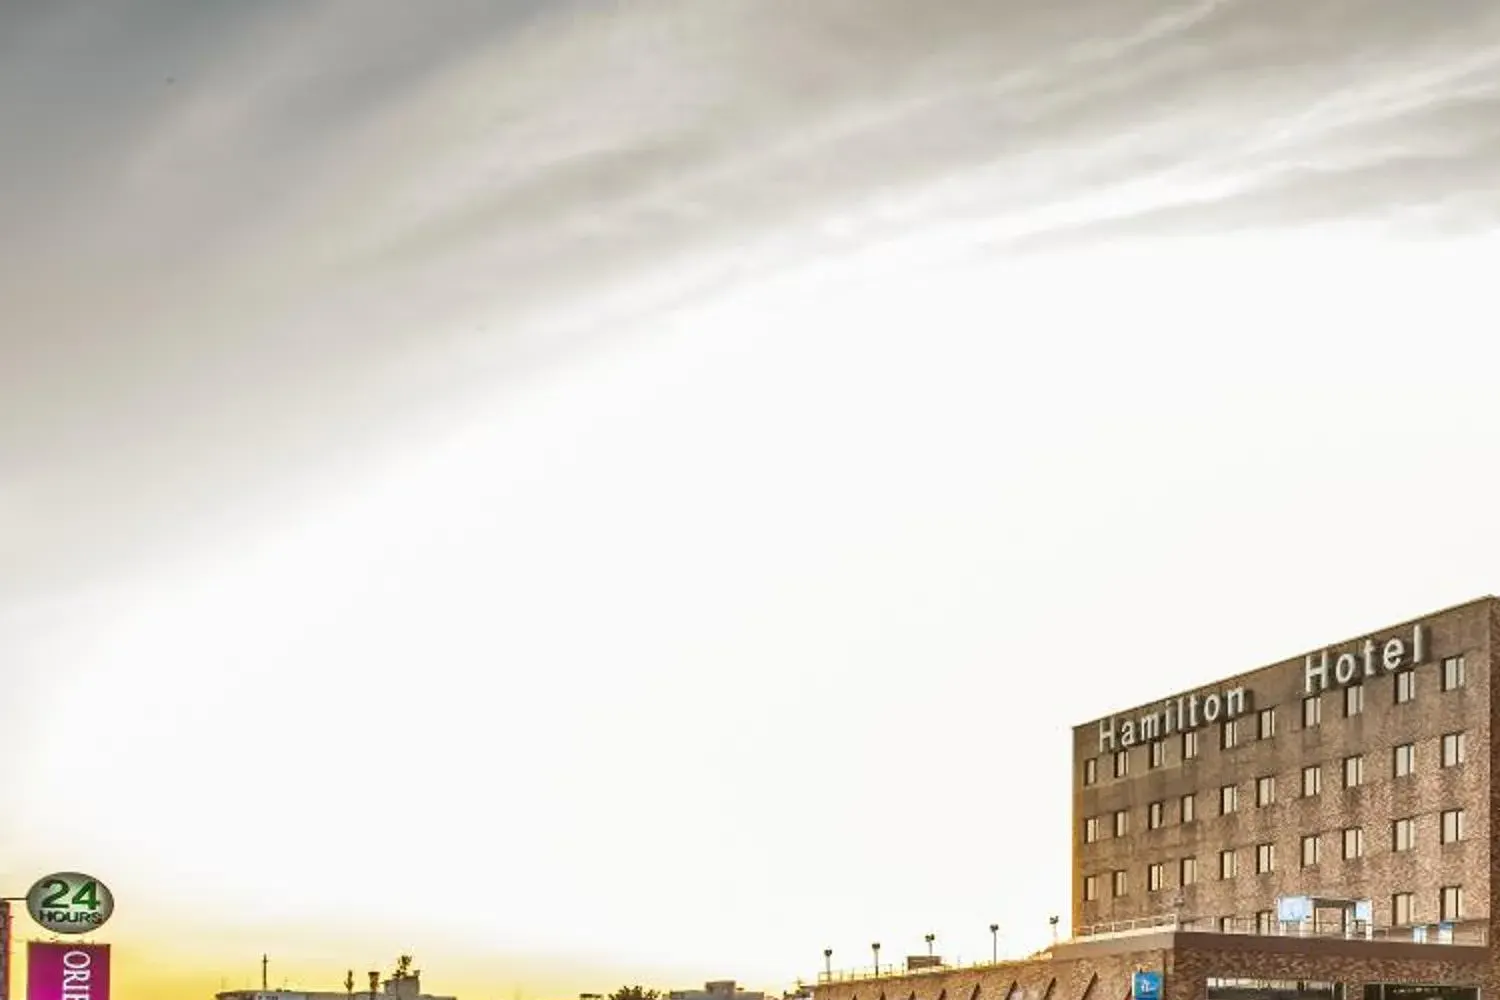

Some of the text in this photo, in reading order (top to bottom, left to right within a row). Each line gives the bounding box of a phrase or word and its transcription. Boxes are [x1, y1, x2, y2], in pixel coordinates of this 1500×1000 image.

[1098, 625, 1429, 755] Hamilton Hotel
[41, 879, 101, 910] 24
[39, 910, 103, 924] HOURS
